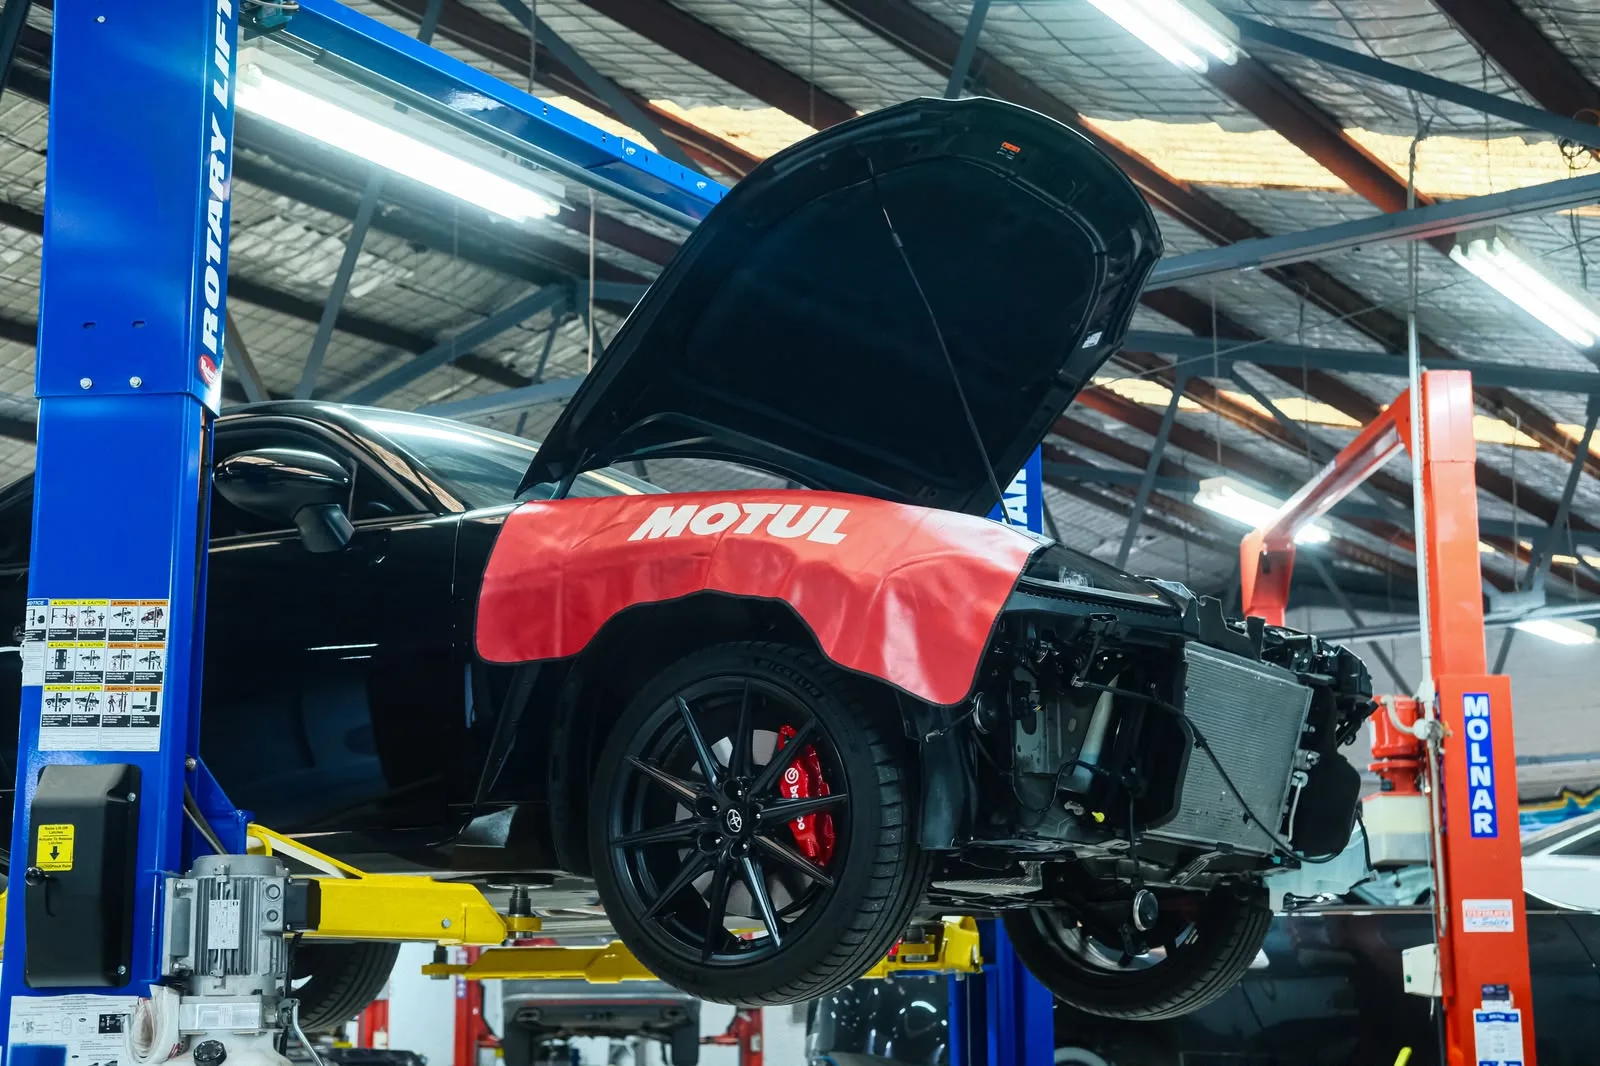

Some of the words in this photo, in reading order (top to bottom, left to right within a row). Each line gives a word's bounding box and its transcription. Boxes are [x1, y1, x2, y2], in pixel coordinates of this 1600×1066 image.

[203, 113, 226, 355] ROTARY
[627, 502, 851, 545] MOTUL
[1463, 695, 1494, 835] MOLNAR
